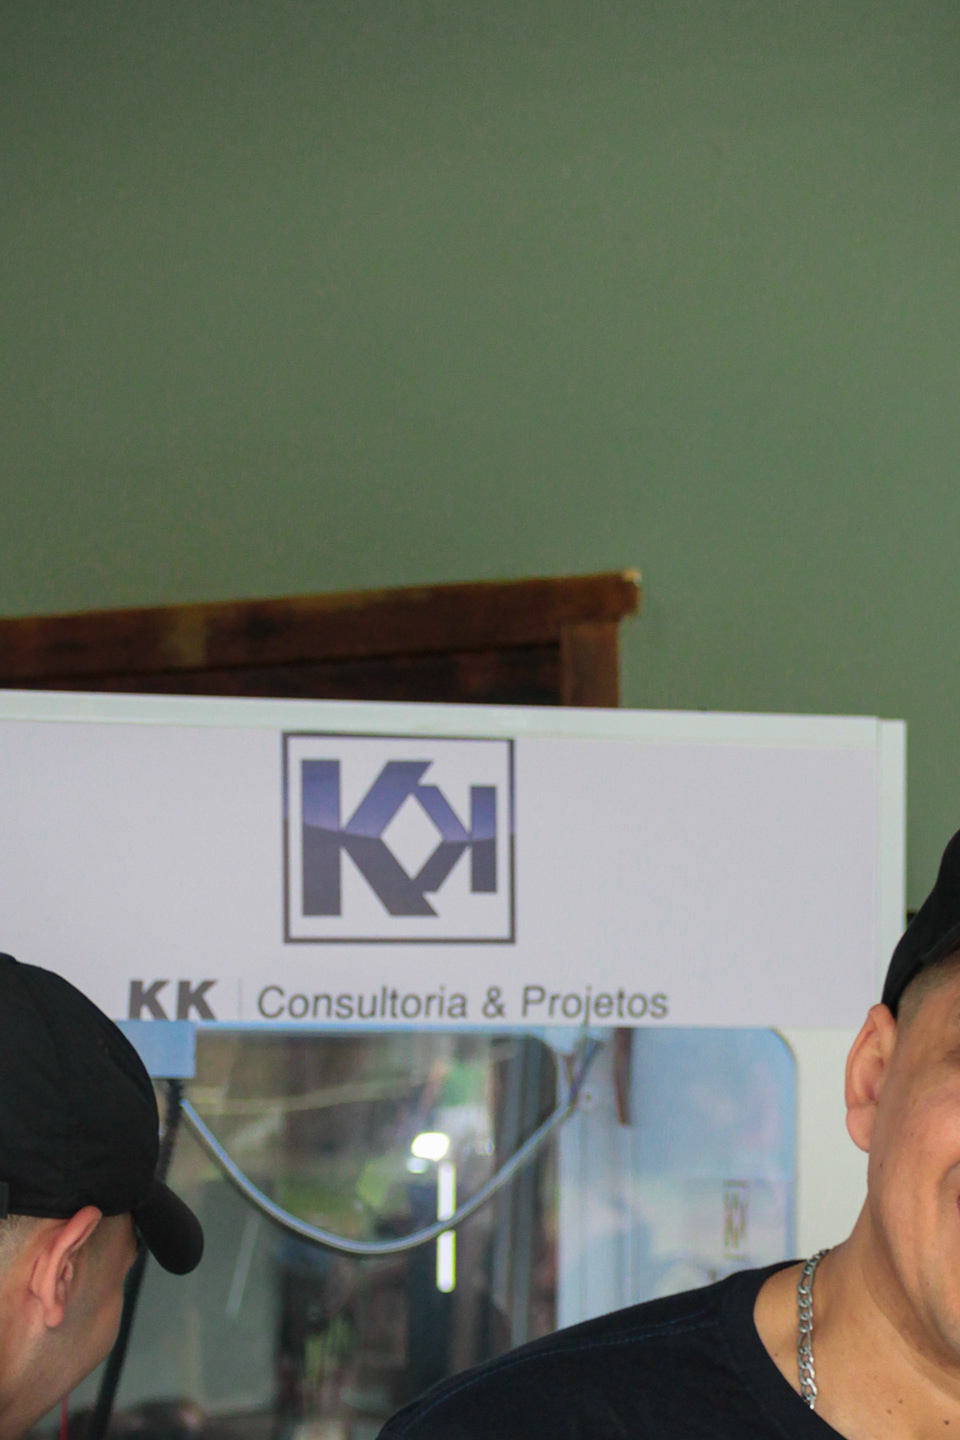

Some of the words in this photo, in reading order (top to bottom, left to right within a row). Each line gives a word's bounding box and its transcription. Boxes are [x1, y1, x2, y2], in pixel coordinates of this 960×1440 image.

[128, 980, 217, 1020] KK
[257, 984, 467, 1018] Consultoria
[482, 985, 505, 1018] &
[521, 984, 668, 1027] Projetos
